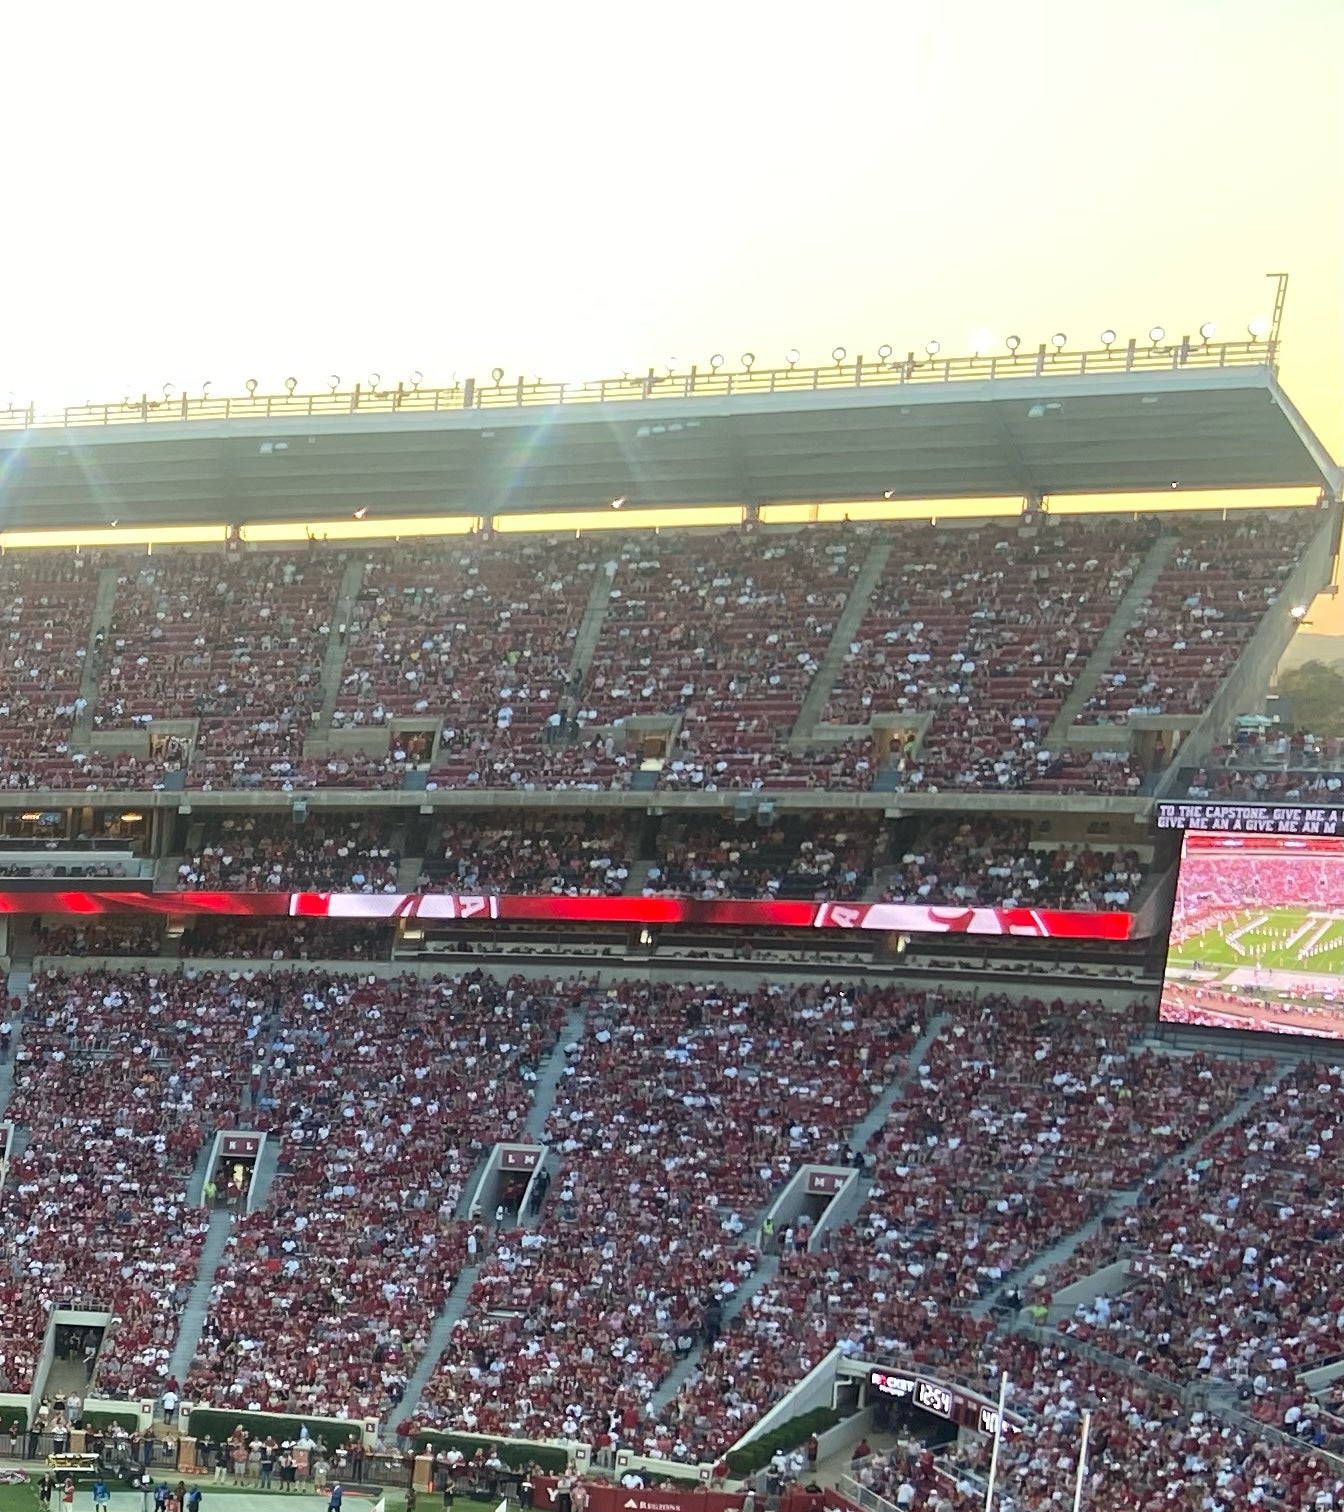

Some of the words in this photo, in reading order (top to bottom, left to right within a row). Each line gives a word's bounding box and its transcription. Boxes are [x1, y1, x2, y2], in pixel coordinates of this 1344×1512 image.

[1160, 805, 1174, 816] TO
[1179, 806, 1201, 817] THE
[1273, 809, 1302, 821] GIVE
[1305, 810, 1324, 821] ME
[1328, 810, 1337, 822] A
[1157, 817, 1185, 829] GIVE
[1188, 818, 1209, 829] ME
[1212, 819, 1229, 830] AN
[1232, 820, 1242, 831] A
[1245, 820, 1275, 832] GIVE
[1278, 821, 1298, 832] ME
[1301, 822, 1319, 834] AN
[1323, 822, 1337, 834] M
[919, 1383, 950, 1412] 12:54
